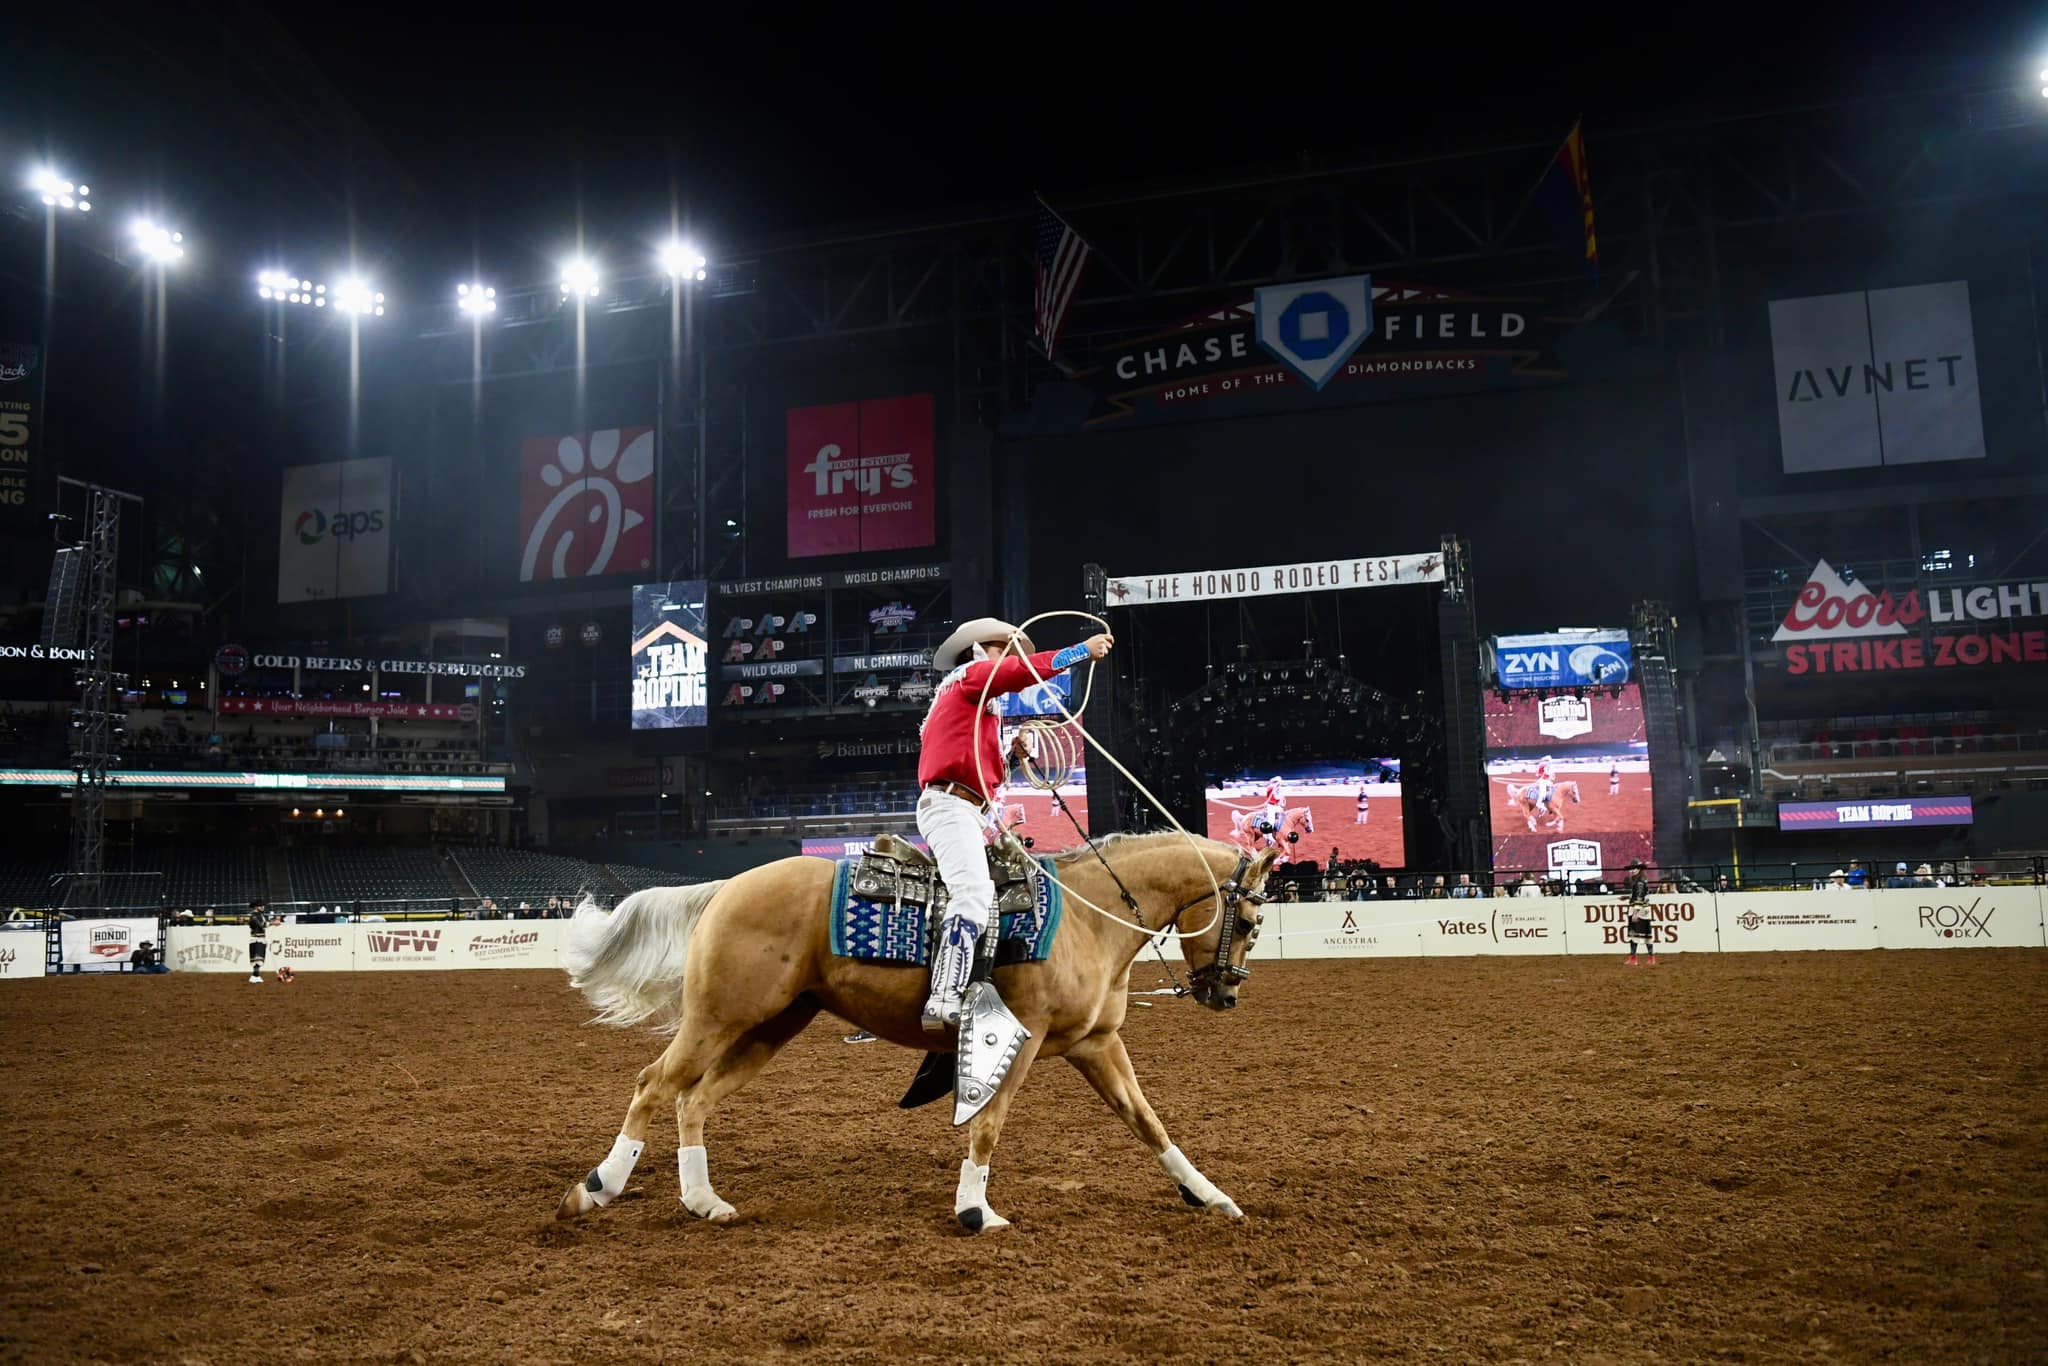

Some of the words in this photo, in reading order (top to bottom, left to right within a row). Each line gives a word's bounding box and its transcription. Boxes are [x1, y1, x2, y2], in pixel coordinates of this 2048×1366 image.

[1115, 333, 1250, 381] CHASE
[1387, 312, 1527, 348] FIELD
[1165, 384, 1211, 401] HOME
[1222, 379, 1243, 392] OF
[1255, 373, 1289, 388] THE
[1350, 359, 1477, 376] DIAMONDBACKS
[1788, 355, 1963, 402] AVNET
[804, 443, 914, 497] fry's
[808, 507, 837, 519] FRESH
[840, 504, 860, 516] FOR
[863, 501, 914, 514] EVERYONE
[330, 509, 384, 544] aps
[844, 572, 878, 585] WORLD
[880, 567, 941, 583] CHAMPIONS
[1145, 579, 1181, 601] THE
[1192, 571, 1262, 597] HONDO
[1274, 564, 1342, 591] RODEO
[1353, 559, 1403, 584] FEST
[720, 584, 732, 595] NL
[735, 581, 762, 594] WEST
[764, 577, 823, 592] CHAMPIONS
[1783, 581, 1926, 633] Coors
[1928, 582, 2048, 624] LIGHT
[31, 645, 45, 659] &
[647, 642, 707, 678] TEAM
[1787, 637, 1926, 675] STRIKE
[1933, 630, 2048, 669] ZONE
[254, 655, 300, 669] COLD
[306, 656, 362, 671] BEERS
[366, 661, 377, 672] &
[381, 661, 526, 679] CHEESEBURGERS
[742, 665, 767, 677] WILD
[770, 664, 797, 676] CARD
[854, 658, 868, 670] NL
[871, 654, 931, 669] CHAMPION
[1505, 651, 1560, 674] ZYN
[1600, 661, 1622, 680] ZYN
[632, 674, 707, 711] ROPING
[837, 740, 894, 757] Banner
[1836, 806, 1870, 822] TEAM
[1871, 804, 1912, 821] ROPING
[1584, 902, 1696, 923] DURNGO
[1918, 897, 1995, 938] ROXX
[95, 931, 127, 942] HONDO
[1438, 919, 1487, 935] Yates
[1504, 928, 1548, 938] GMC
[1602, 925, 1679, 944] BOTS
[201, 933, 220, 943] THE
[285, 937, 342, 948] Equipment
[368, 930, 441, 952] VFW
[469, 932, 538, 952] American
[1323, 937, 1380, 945] ANCESTRAL
[177, 943, 243, 964] STILLERY
[284, 948, 314, 959] Share
